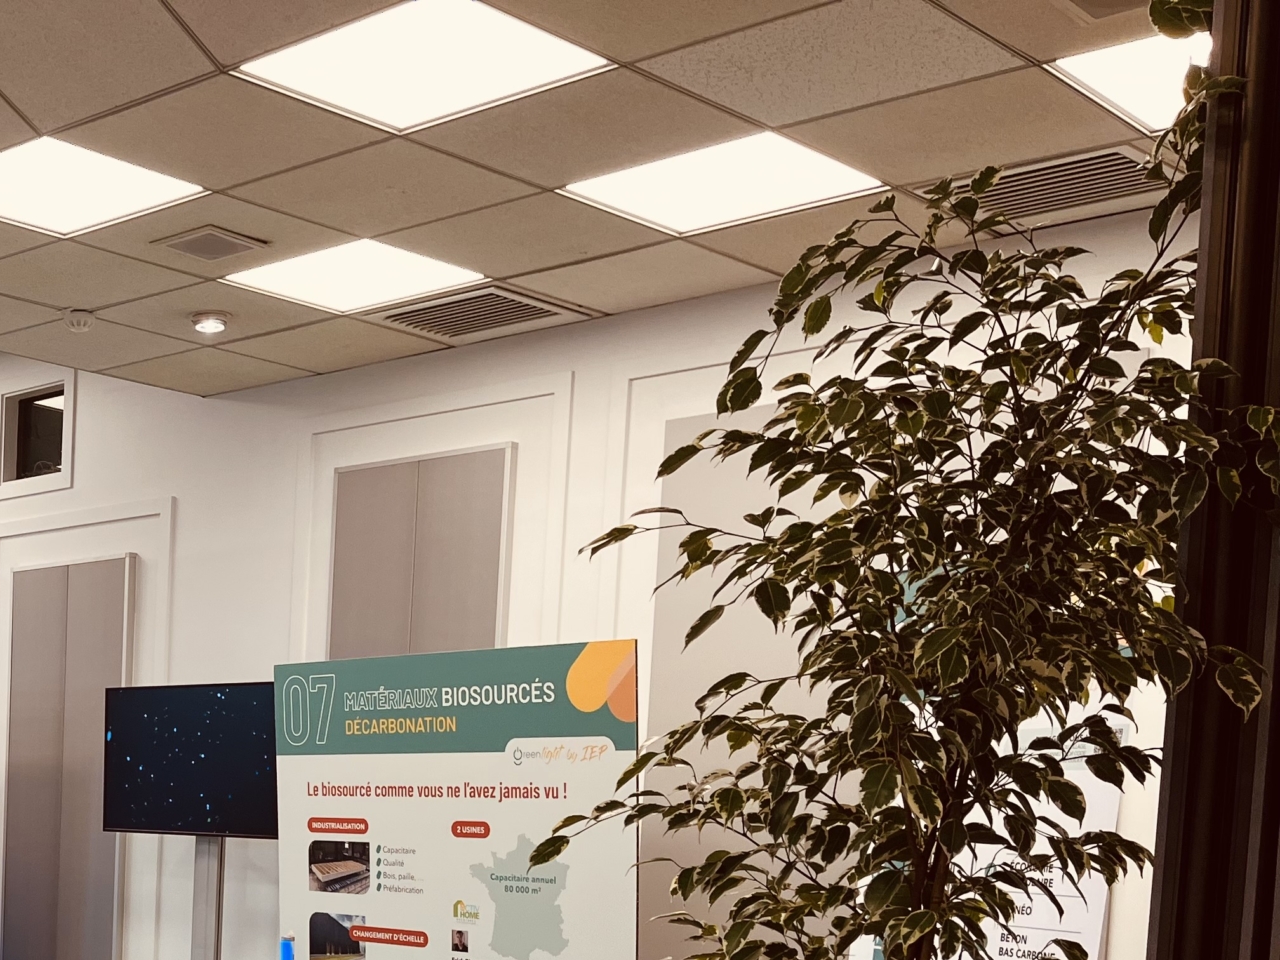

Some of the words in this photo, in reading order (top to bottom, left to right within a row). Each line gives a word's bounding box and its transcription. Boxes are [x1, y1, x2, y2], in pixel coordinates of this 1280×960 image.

[283, 674, 336, 745] 07
[344, 686, 437, 711] MATÉRIAUX
[442, 678, 555, 707] BIOSOURCÉS
[345, 716, 456, 735] DÉCARBONATION
[580, 744, 608, 761] IEP
[307, 782, 318, 797] Le
[321, 782, 372, 797] biosourcé
[375, 785, 414, 798] comme
[417, 785, 443, 798] vous
[447, 785, 461, 798] ne
[464, 782, 496, 798] l'avez
[498, 782, 540, 802] jamais
[544, 785, 559, 799] vu
[563, 782, 567, 799] !
[312, 822, 365, 830] INDUSTRIALISATION
[462, 826, 485, 834] USINES
[383, 846, 416, 855] Capacitaire
[383, 859, 404, 867] Qualité
[490, 873, 529, 883] Capacitaire
[531, 876, 556, 884] annuel
[383, 884, 424, 894] Préfabrication
[504, 885, 513, 893] 80
[515, 886, 529, 894] 000
[353, 930, 392, 940] CHANGEMENT
[394, 933, 424, 943] D'ÉCHELLE
[999, 947, 1014, 957] BAS
